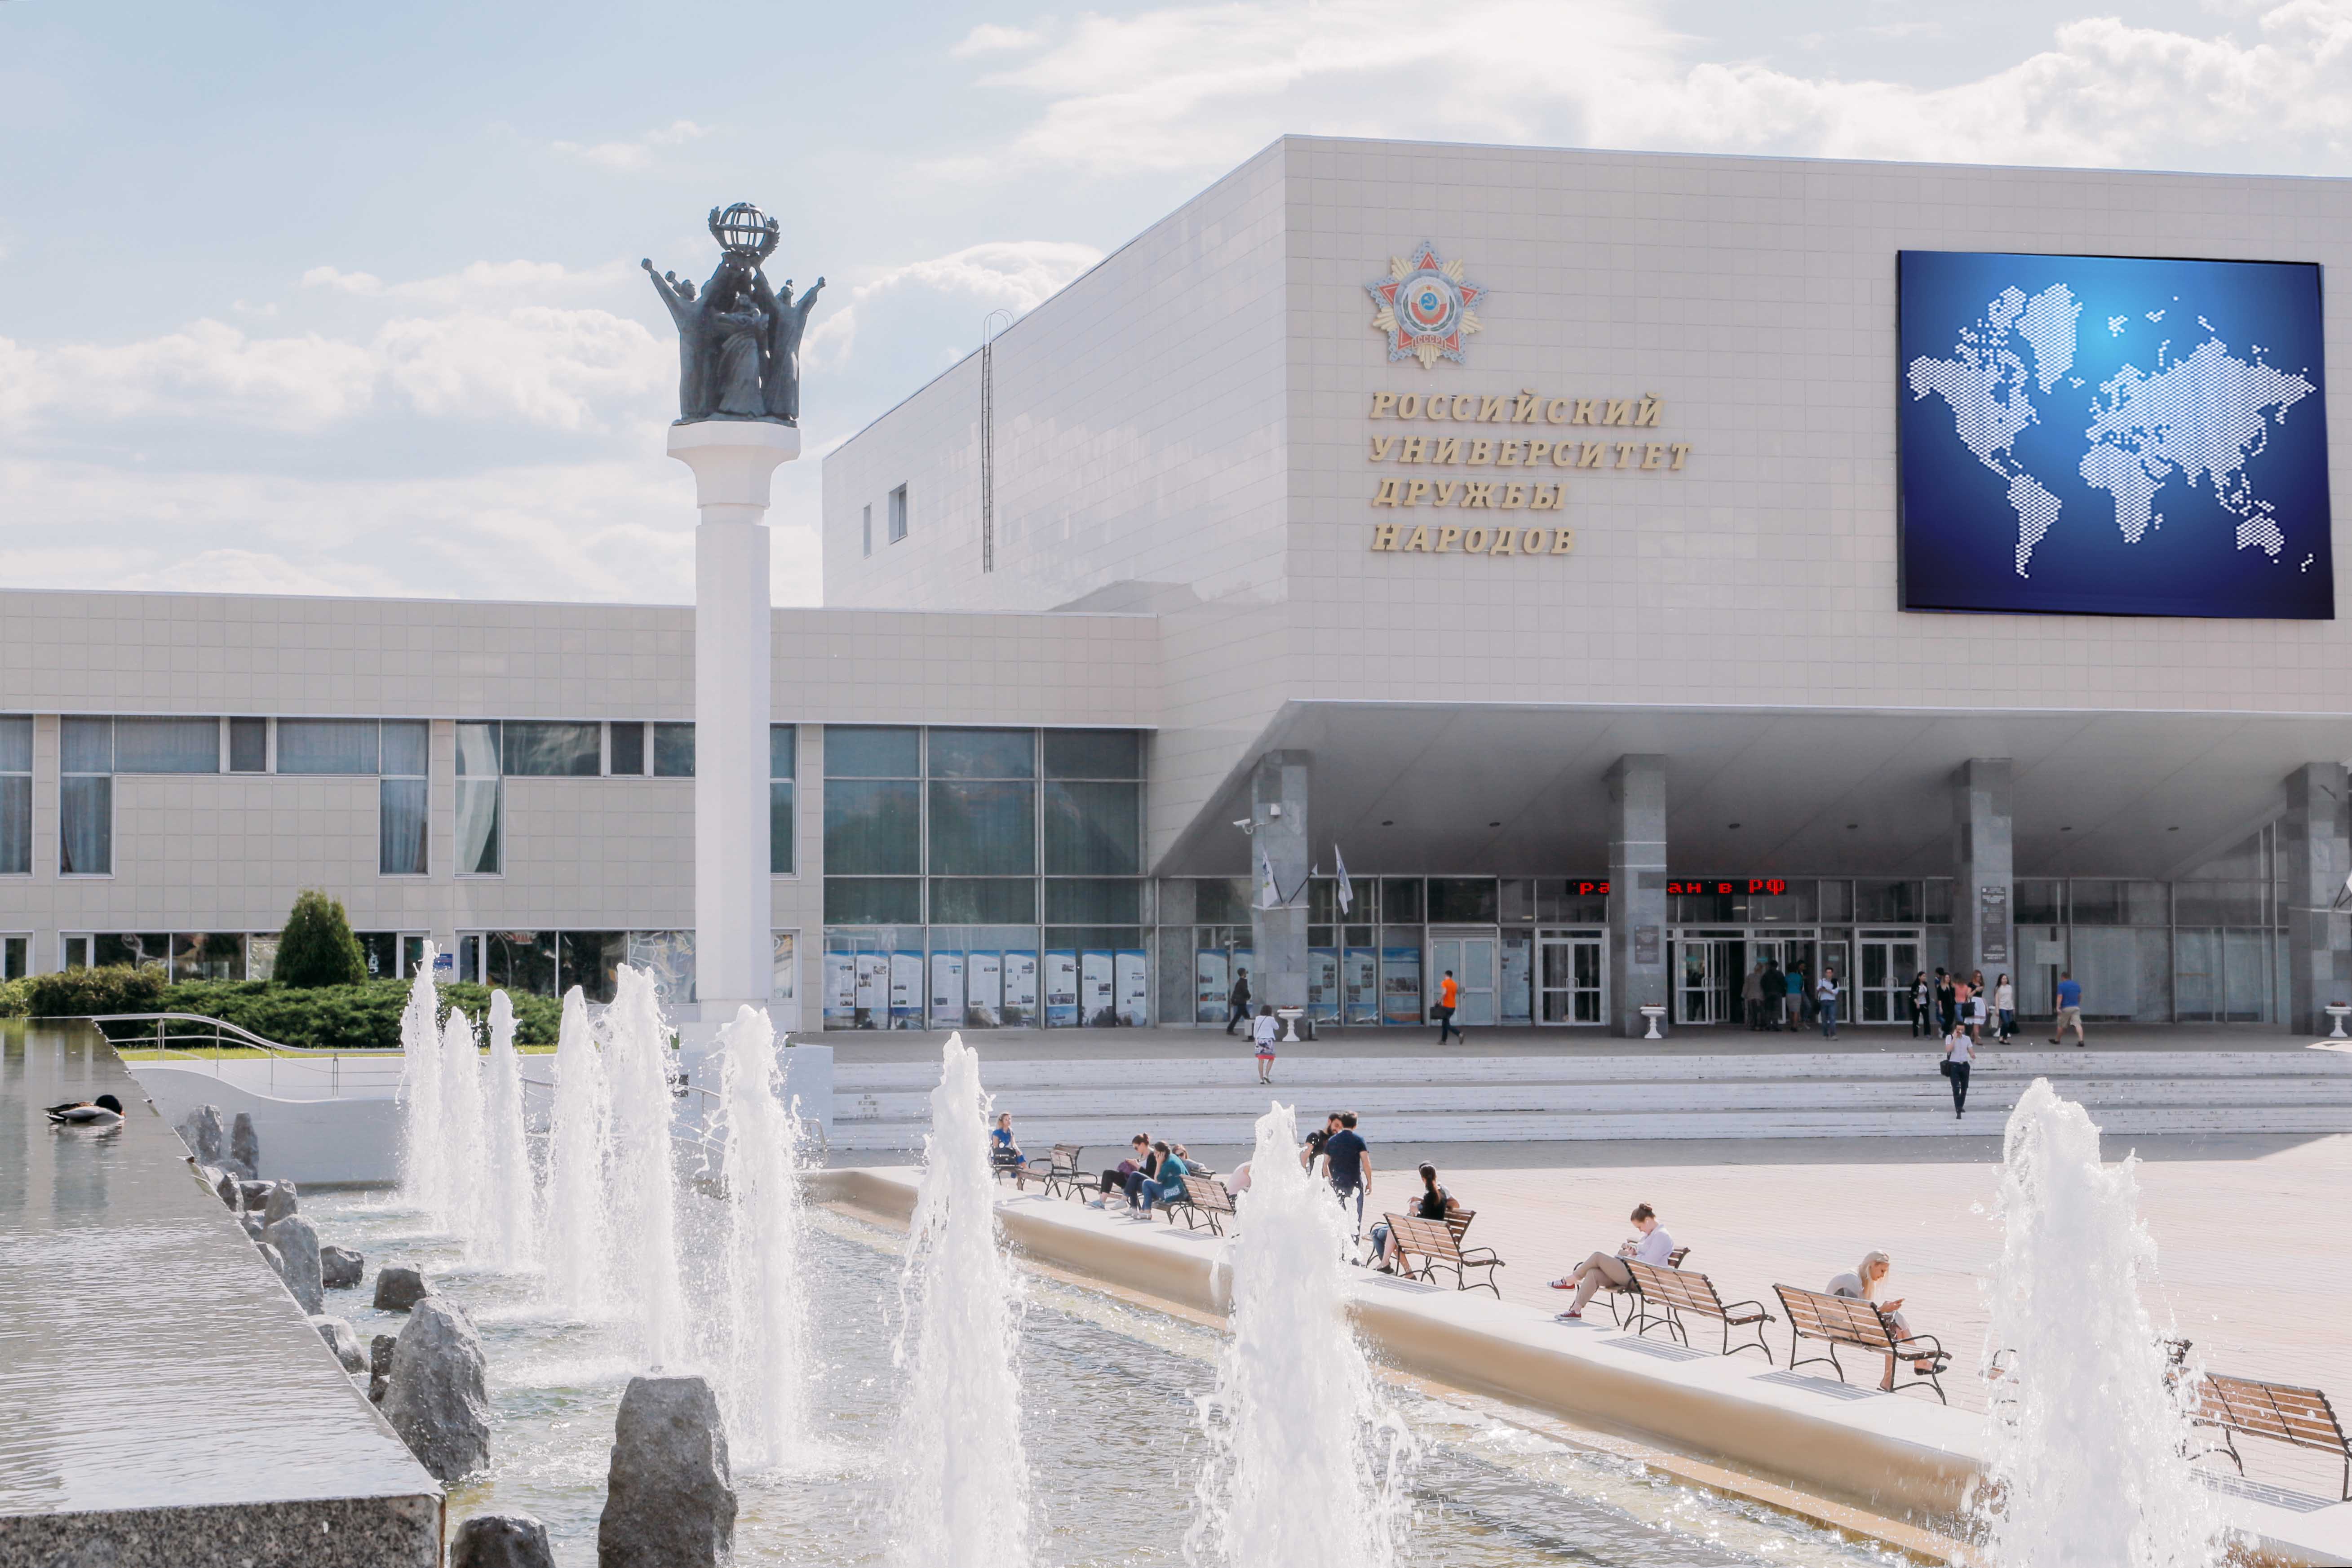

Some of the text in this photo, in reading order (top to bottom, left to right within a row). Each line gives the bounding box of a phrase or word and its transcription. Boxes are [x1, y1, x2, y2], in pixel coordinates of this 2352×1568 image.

[1417, 335, 1440, 343] СССР
[1369, 388, 1666, 426] РОССИЙСКИЙ
[1369, 435, 1693, 470] УНИВЕРСИТЕТ
[1370, 478, 1568, 510] ДРУЖБЫ
[1372, 523, 1576, 555] НАРОДОВ
[1718, 882, 1732, 894] в
[1749, 879, 1785, 895] РФ
